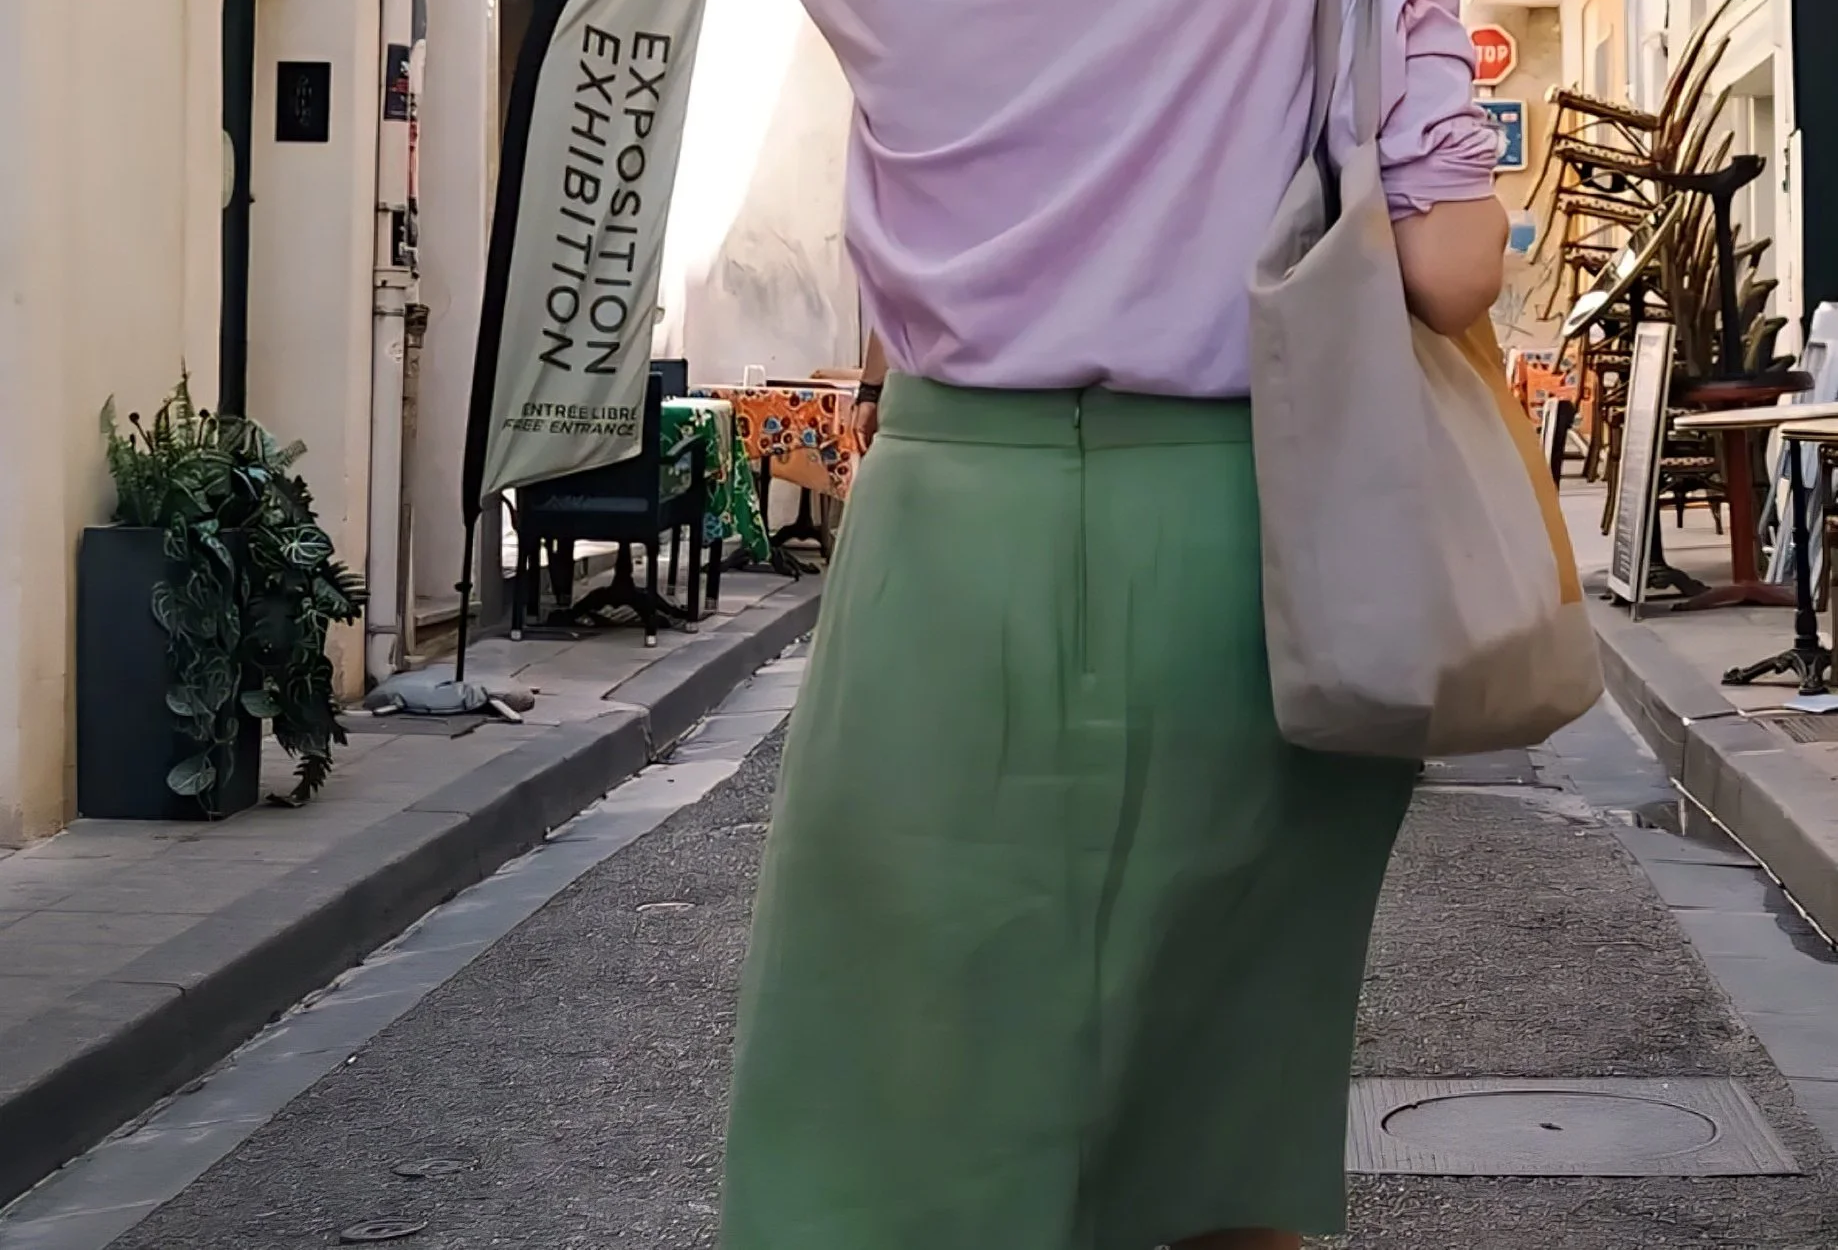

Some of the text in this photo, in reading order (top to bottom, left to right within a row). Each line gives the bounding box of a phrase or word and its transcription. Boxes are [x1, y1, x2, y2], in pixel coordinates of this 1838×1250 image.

[1475, 45, 1509, 63] TOP
[538, 24, 621, 371] EXHIBITION
[584, 31, 671, 374] EXPOSITION
[549, 420, 635, 436] ENTRANCE
